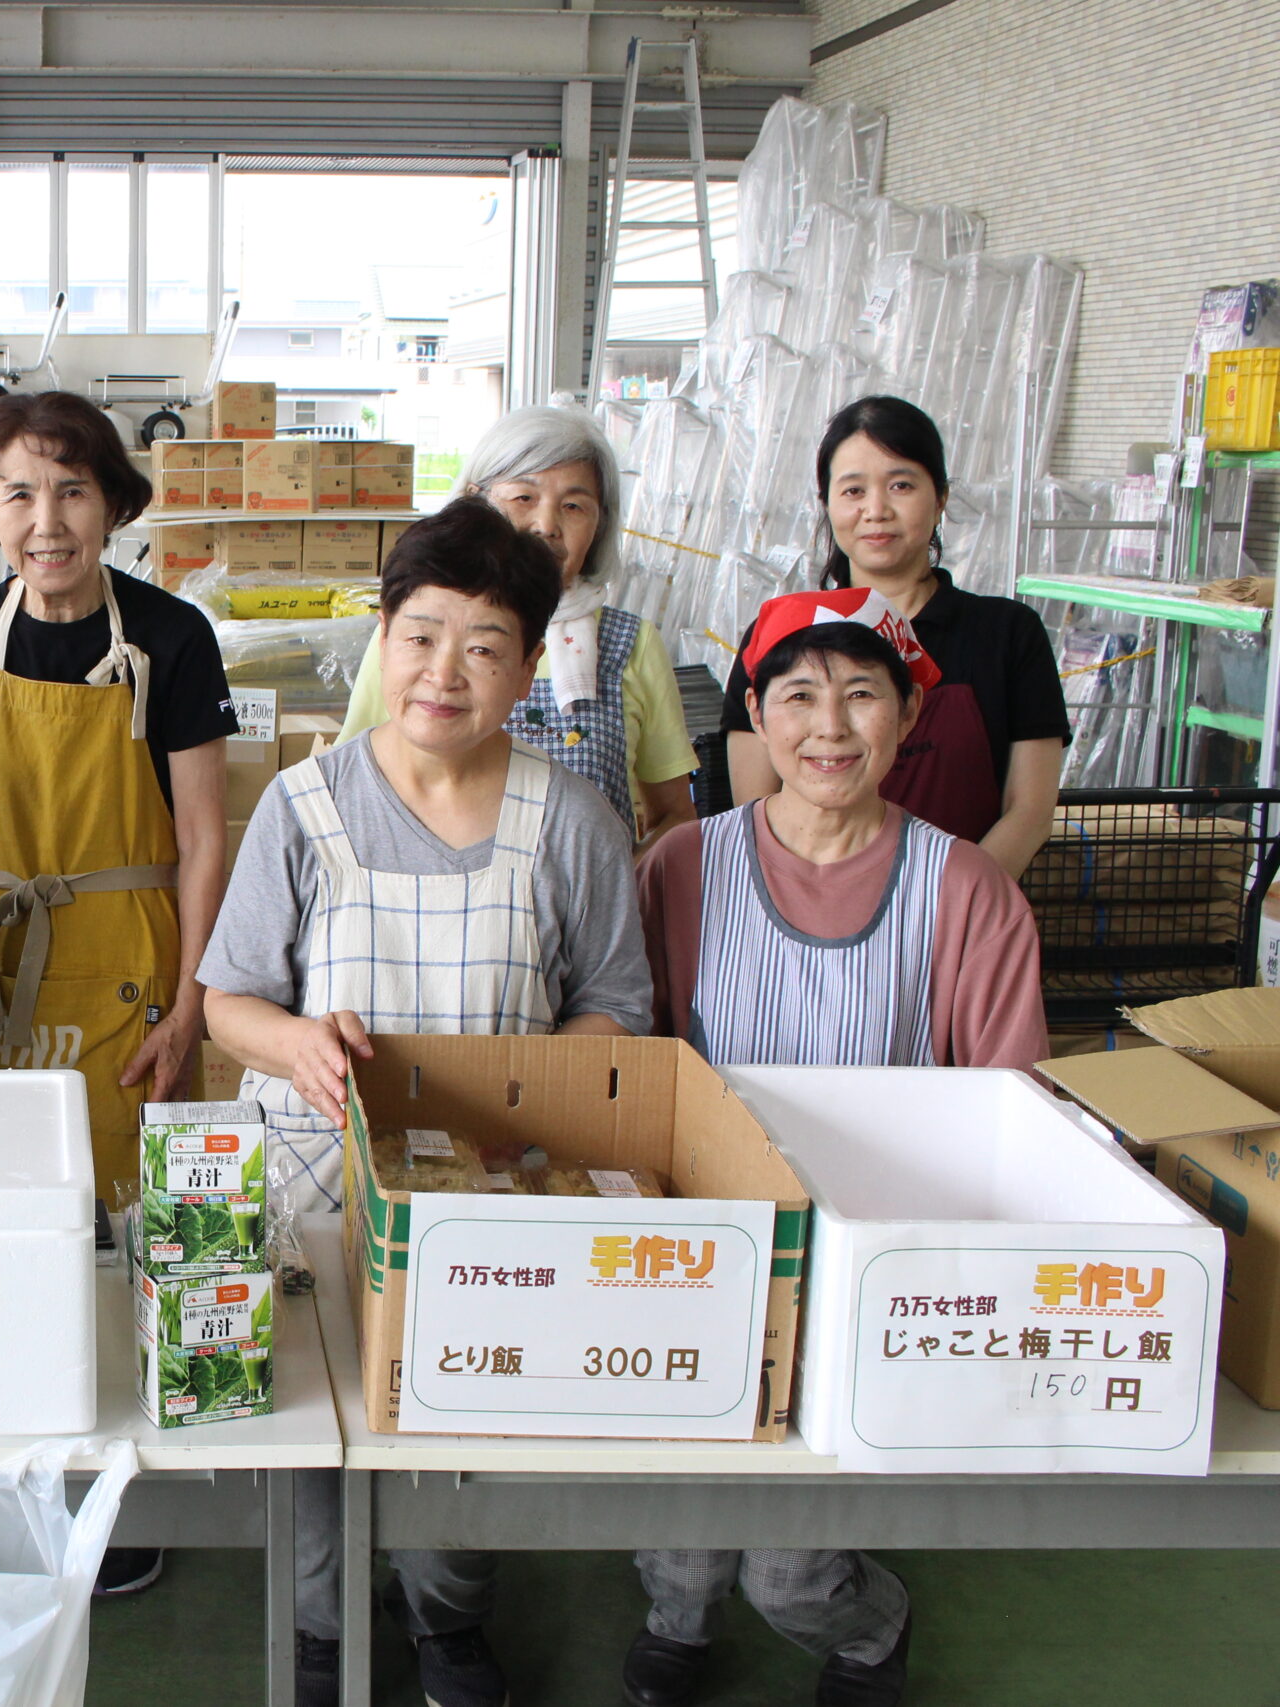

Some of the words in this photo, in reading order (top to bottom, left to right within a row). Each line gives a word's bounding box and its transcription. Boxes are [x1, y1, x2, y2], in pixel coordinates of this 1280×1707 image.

[187, 1168, 222, 1187] 青汁
[590, 1235, 715, 1279] 手作り
[448, 1265, 556, 1288] 乃万女性部
[1033, 1262, 1165, 1308] 手作り
[889, 1295, 997, 1317] 乃万女性部
[201, 1318, 233, 1339] 青汁
[882, 1327, 1173, 1361] じゃこと梅干し飯
[438, 1345, 523, 1375] とり飯
[1030, 1372, 1087, 1398] 150
[1105, 1377, 1141, 1411] 円
